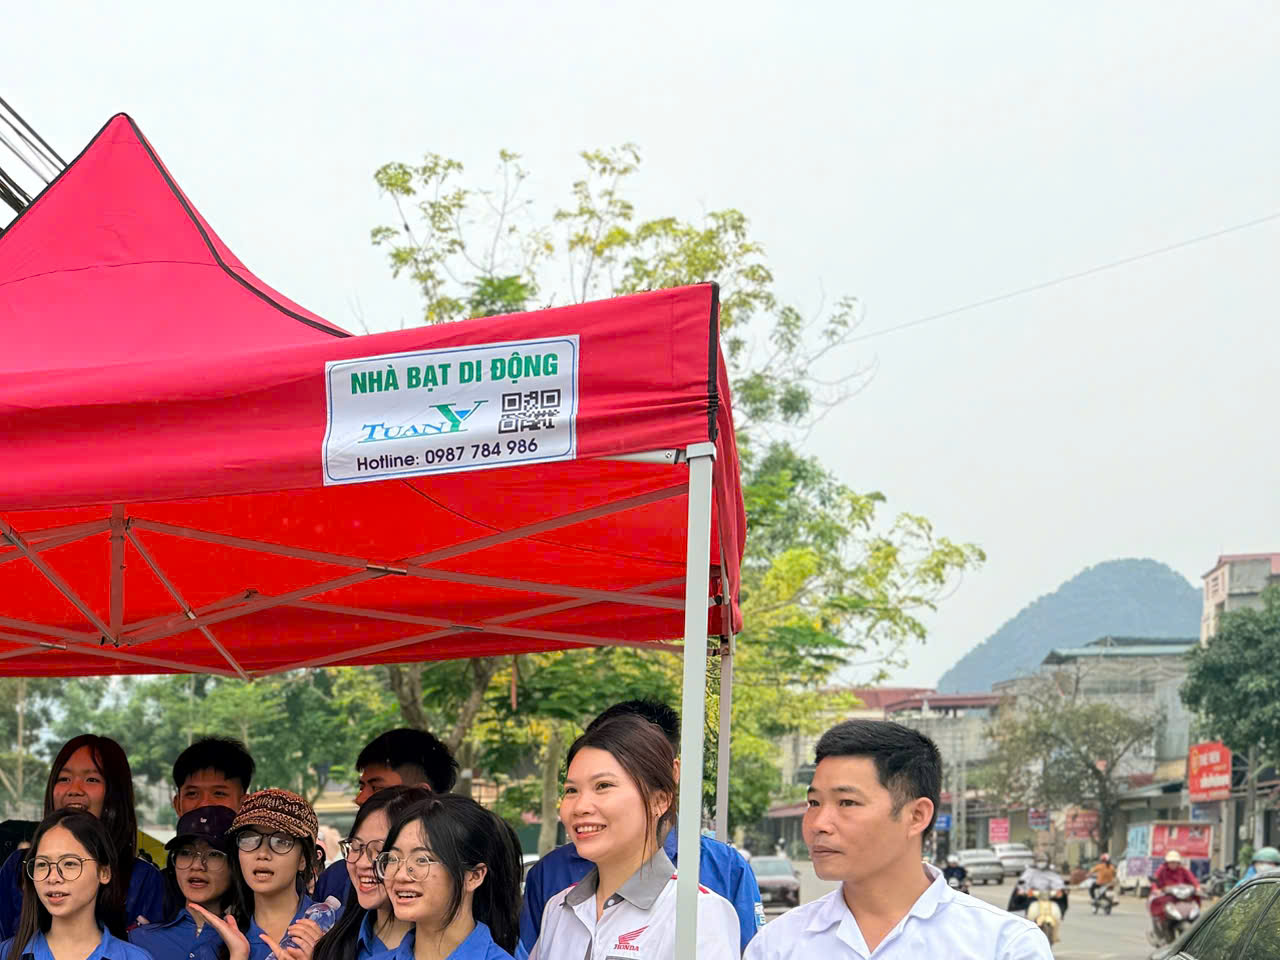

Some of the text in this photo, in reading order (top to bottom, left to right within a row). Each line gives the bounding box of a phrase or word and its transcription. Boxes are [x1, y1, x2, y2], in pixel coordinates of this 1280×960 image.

[351, 352, 558, 394] NHÀ BẠT DI ĐỘNG
[357, 438, 538, 472] Hotline: 0987 784 986
[613, 943, 639, 951] HONDA
